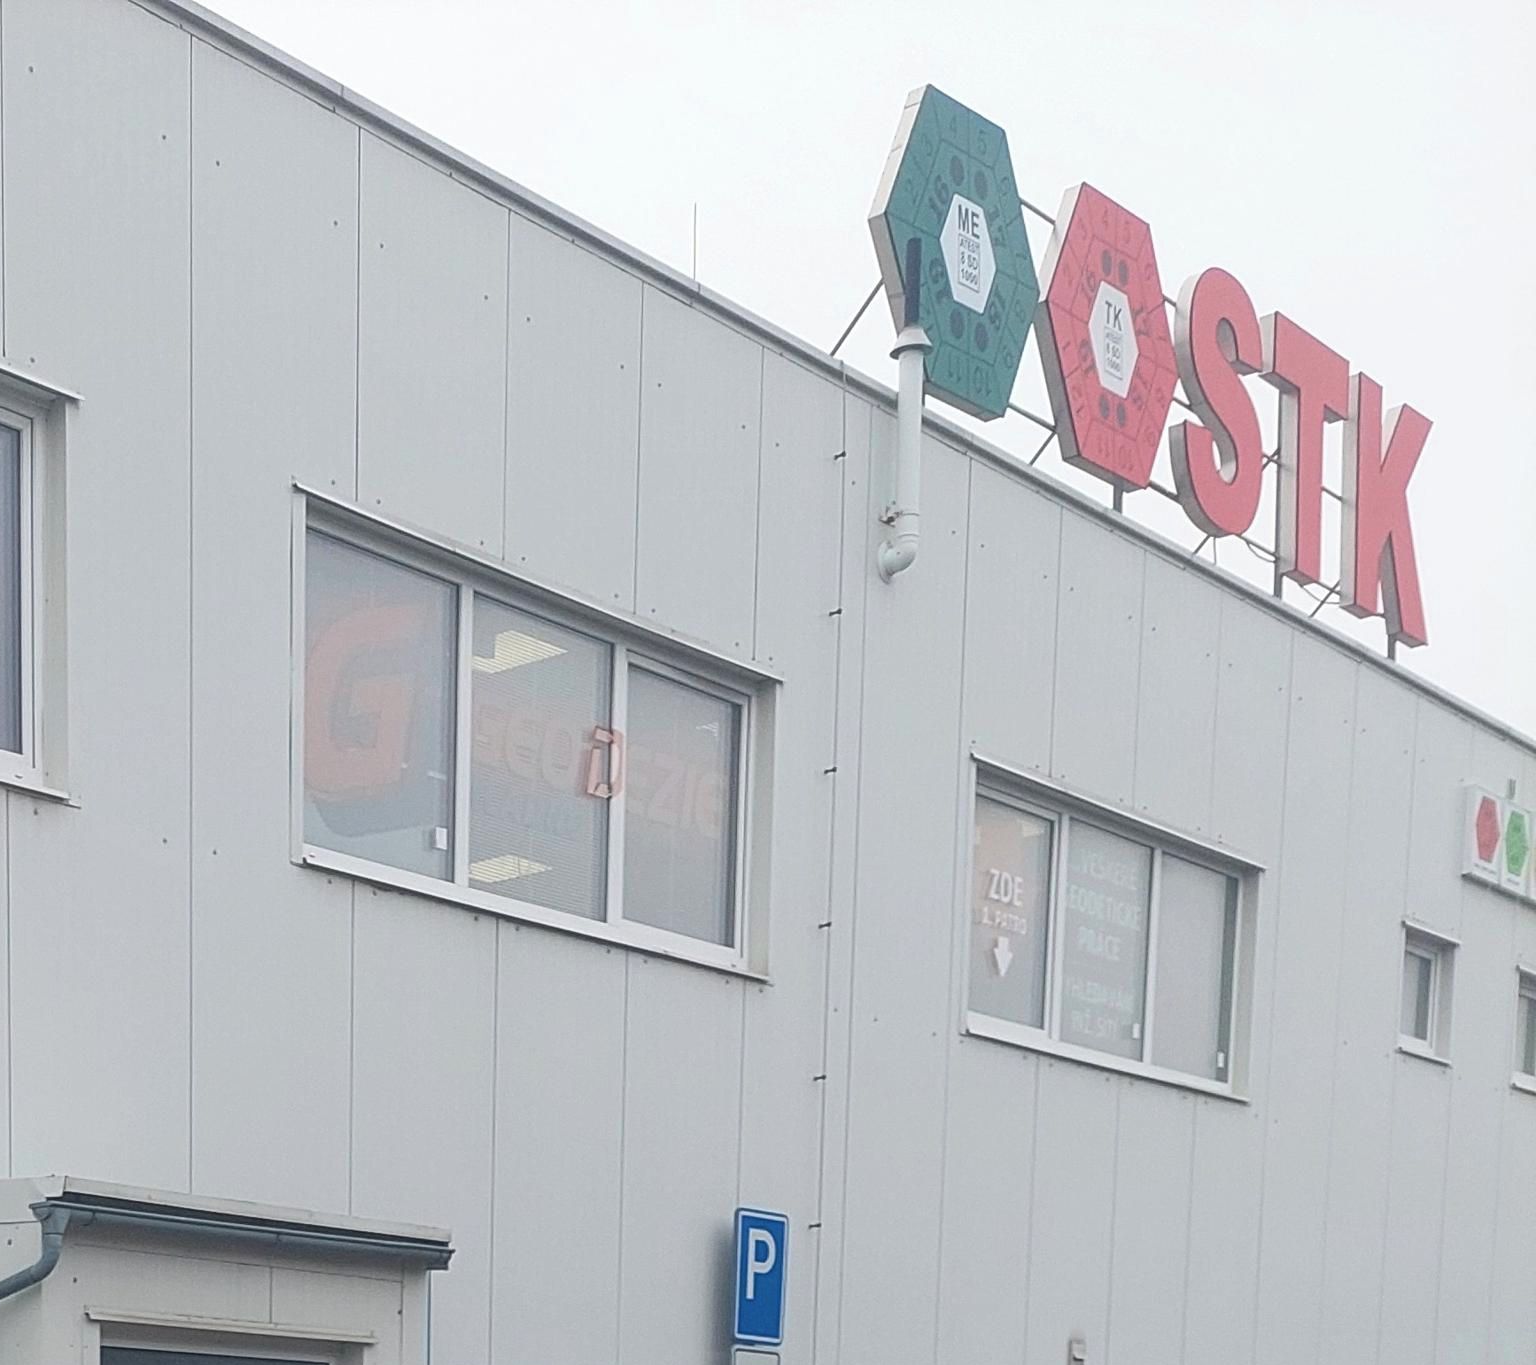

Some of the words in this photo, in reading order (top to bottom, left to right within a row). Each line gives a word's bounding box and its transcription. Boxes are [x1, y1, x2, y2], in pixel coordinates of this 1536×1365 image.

[922, 132, 934, 158] 3
[976, 128, 989, 156] 5
[957, 203, 981, 240] ME
[1105, 300, 1123, 332] TK
[1169, 267, 1433, 646] STK
[989, 867, 1024, 908] ZDE
[746, 1227, 776, 1300] P
